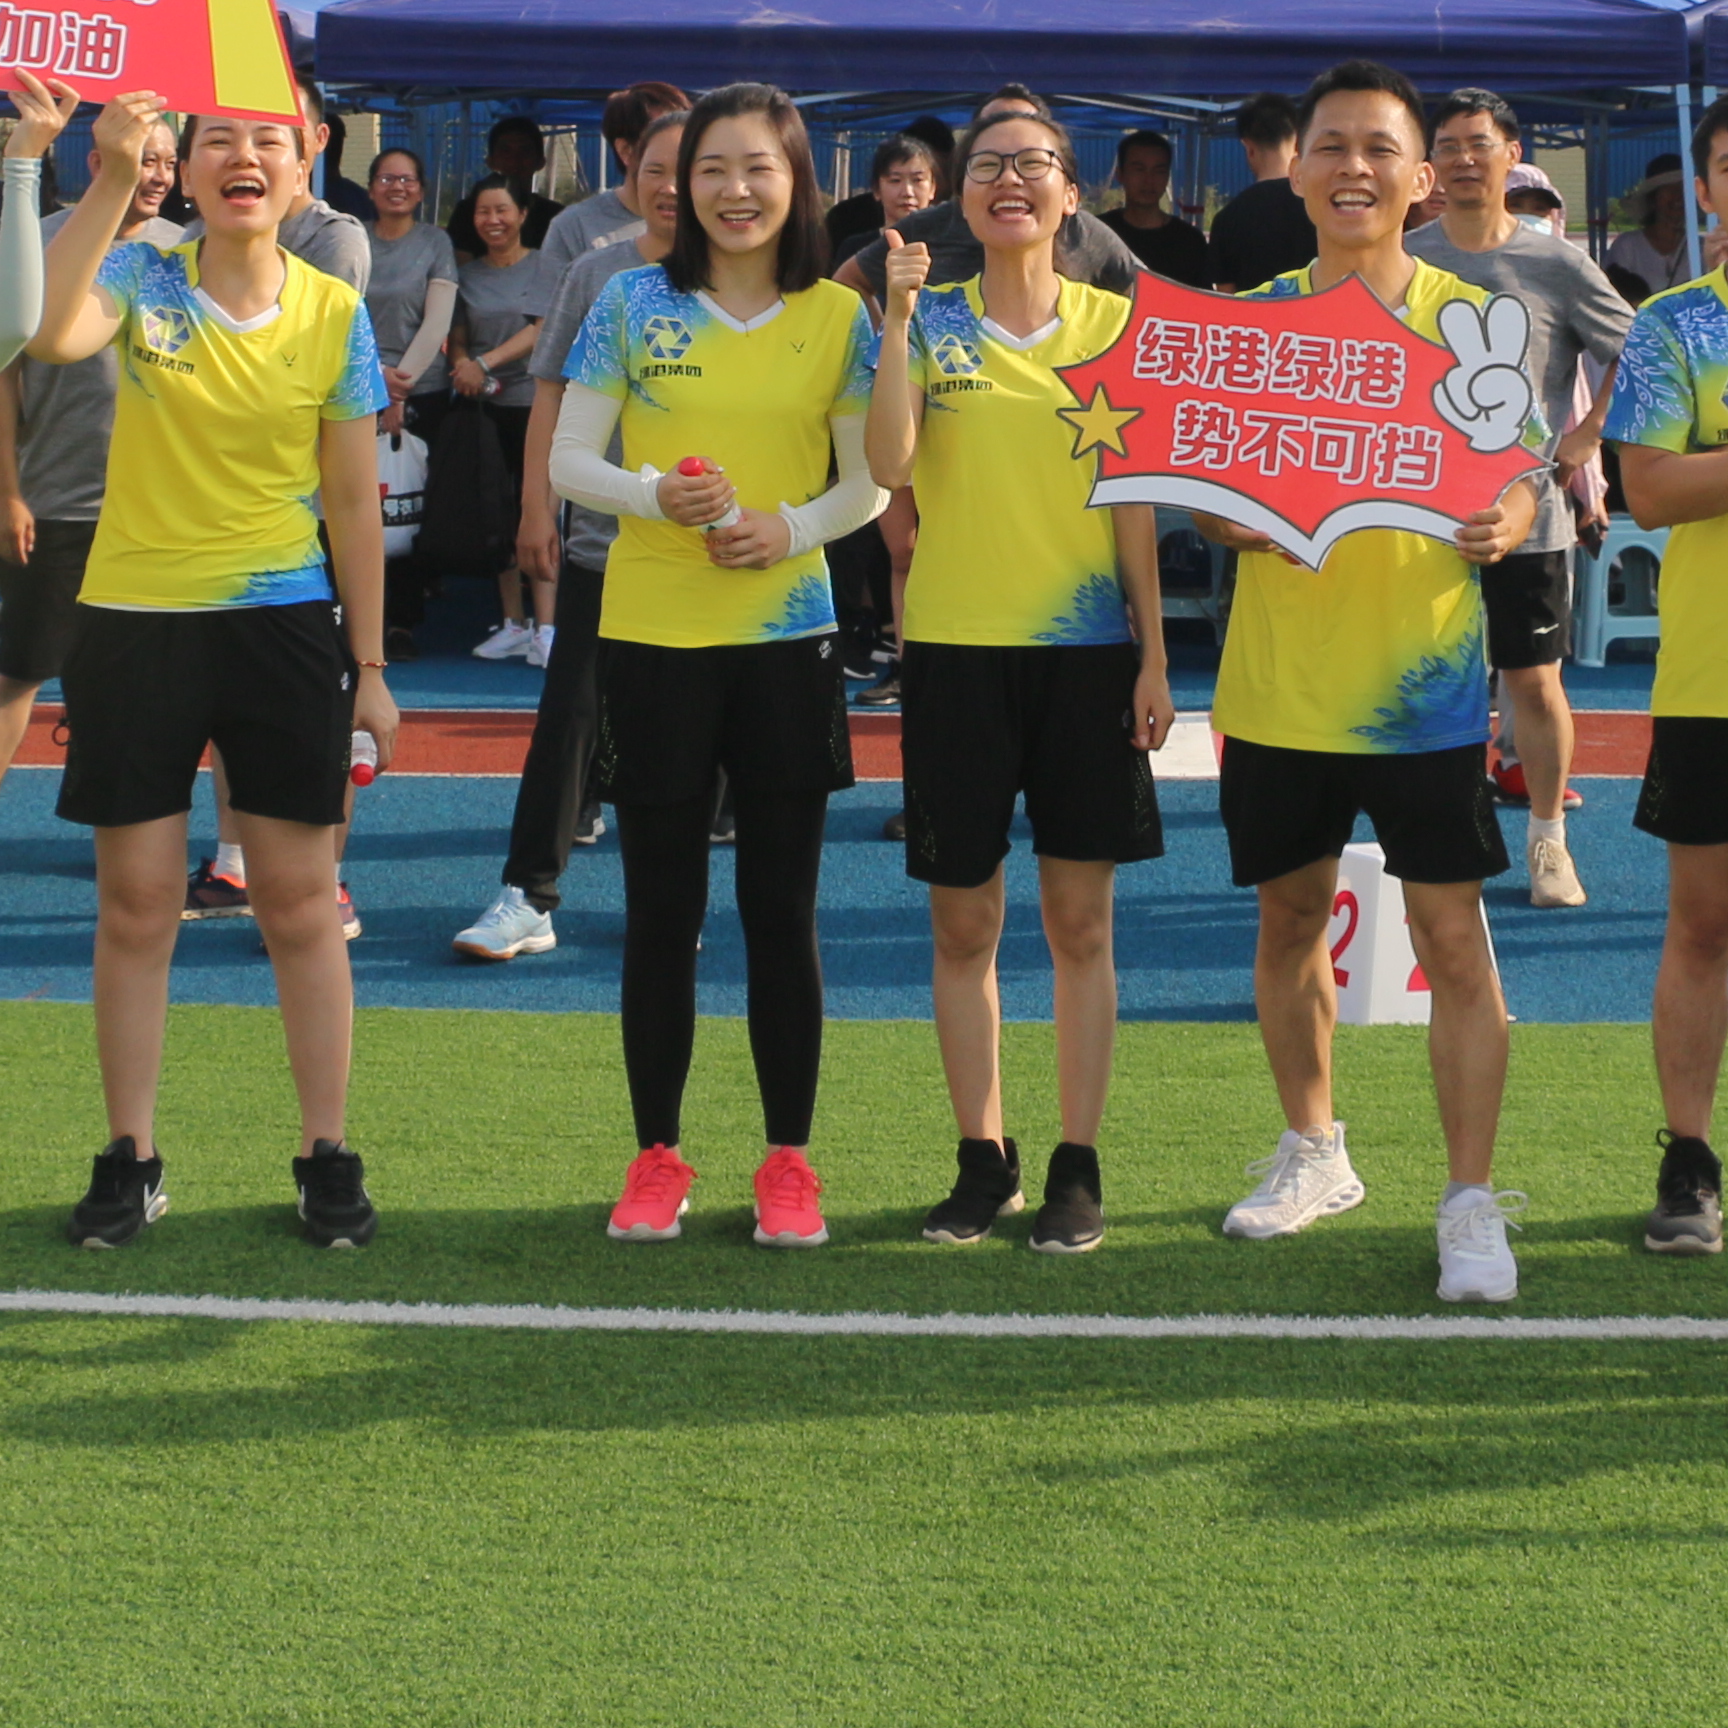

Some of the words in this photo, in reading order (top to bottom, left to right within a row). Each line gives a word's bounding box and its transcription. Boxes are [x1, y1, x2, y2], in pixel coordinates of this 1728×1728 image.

[930, 379, 993, 397] 绿港集团
[1133, 317, 1406, 408] 绿港绿港
[1170, 400, 1443, 490] 势不可挡
[1331, 890, 1359, 988] 2
